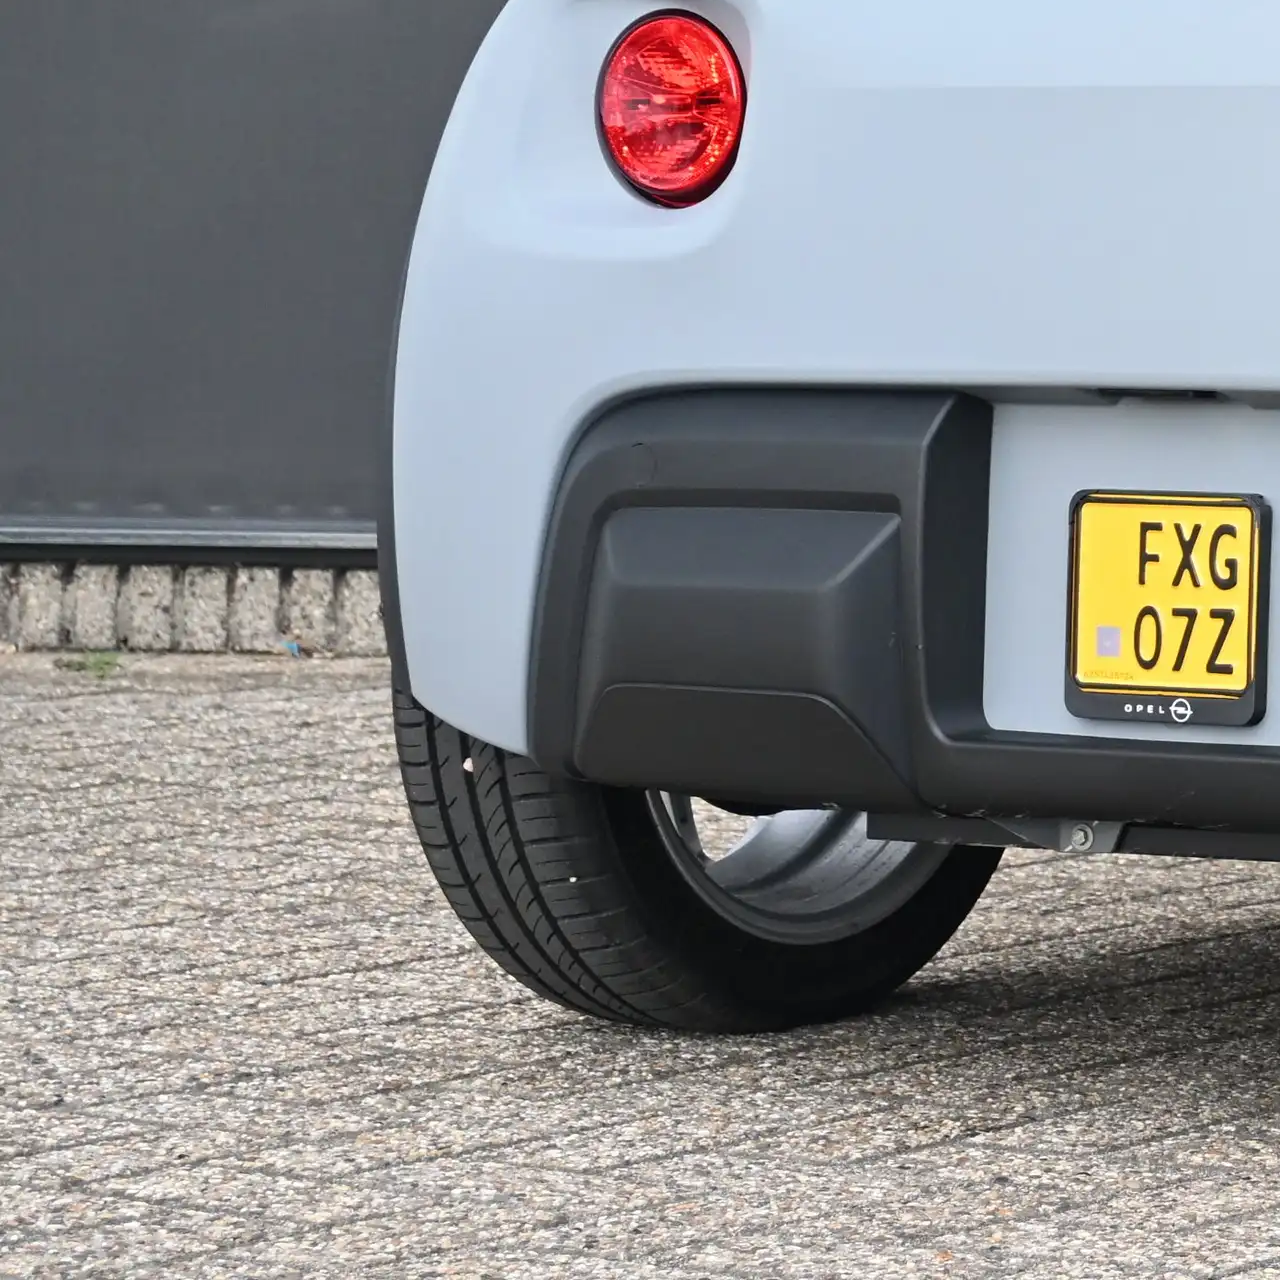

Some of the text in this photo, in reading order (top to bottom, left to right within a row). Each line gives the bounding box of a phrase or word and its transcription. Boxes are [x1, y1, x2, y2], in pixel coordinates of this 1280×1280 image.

[1138, 521, 1238, 591] FXG
[1133, 605, 1235, 675] 07Z
[1123, 703, 1165, 714] OPEL
